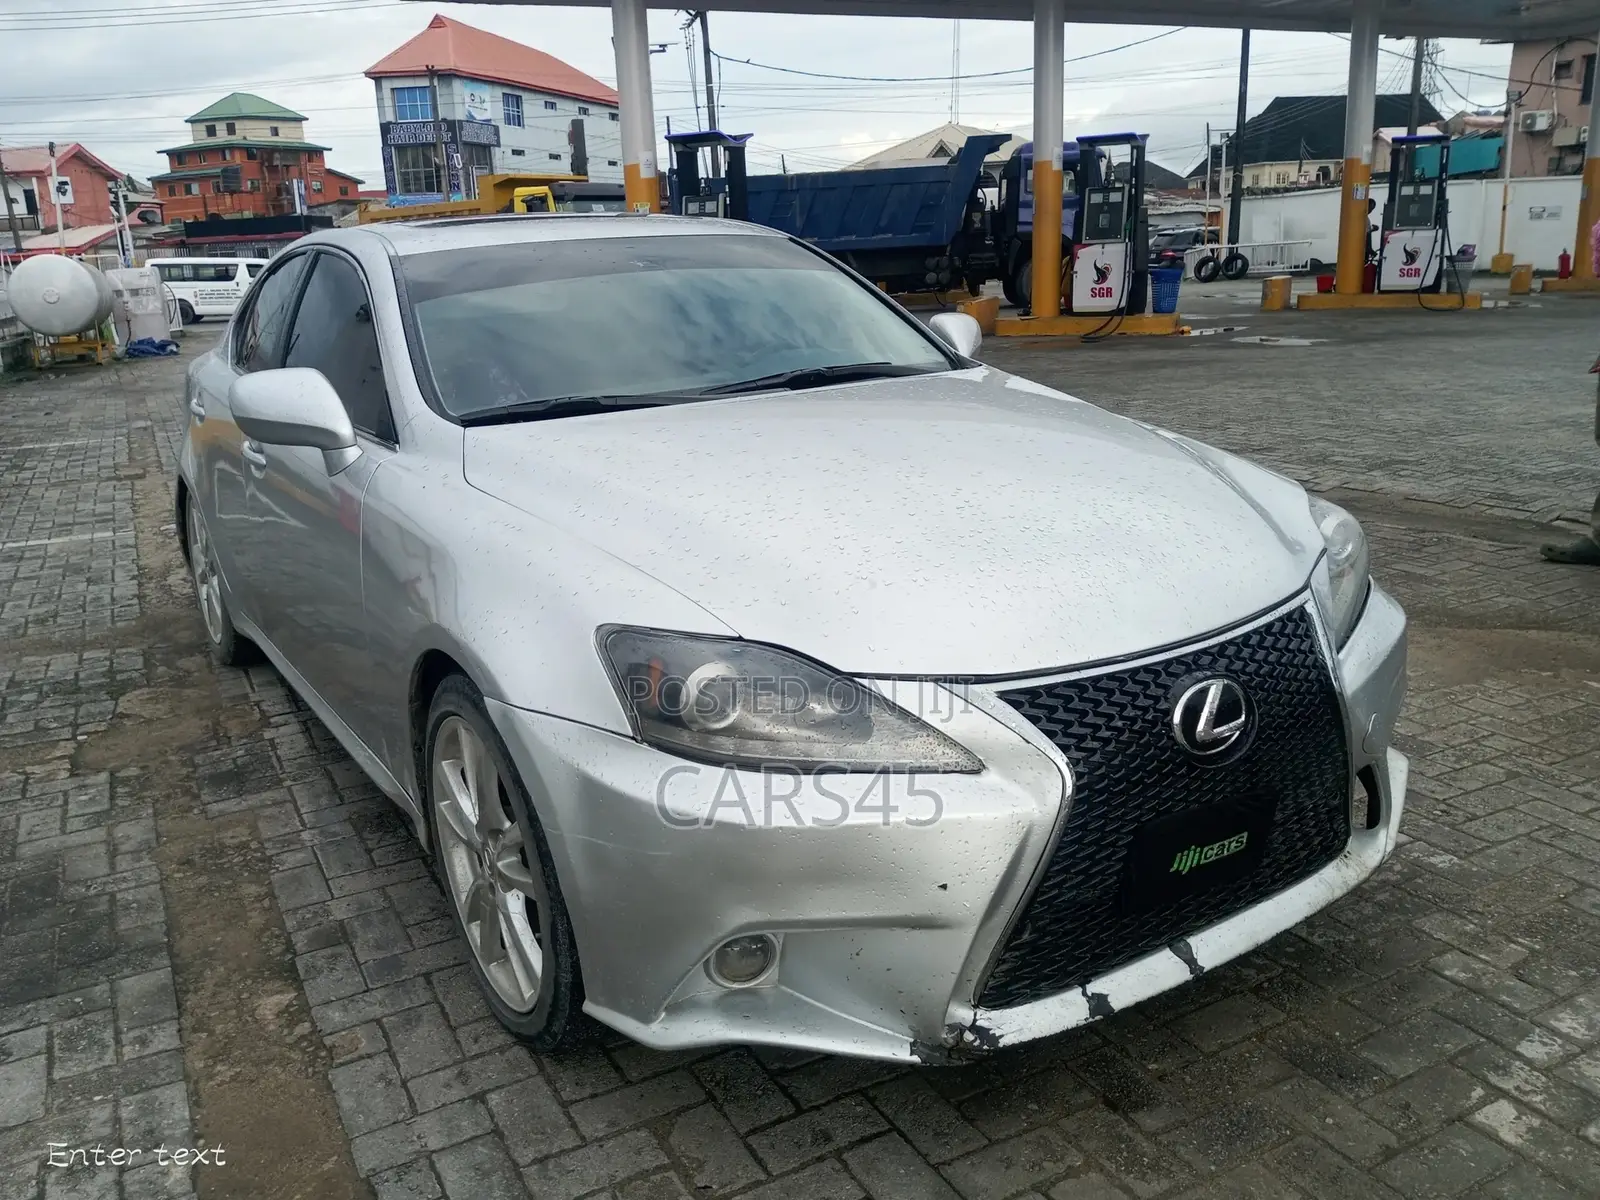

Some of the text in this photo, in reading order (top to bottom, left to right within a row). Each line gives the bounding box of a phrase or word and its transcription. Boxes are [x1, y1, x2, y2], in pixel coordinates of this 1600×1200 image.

[391, 122, 447, 134] BABYLOD
[388, 134, 416, 144] HAIR
[1399, 267, 1421, 278] SGR
[1090, 286, 1112, 298] SGR
